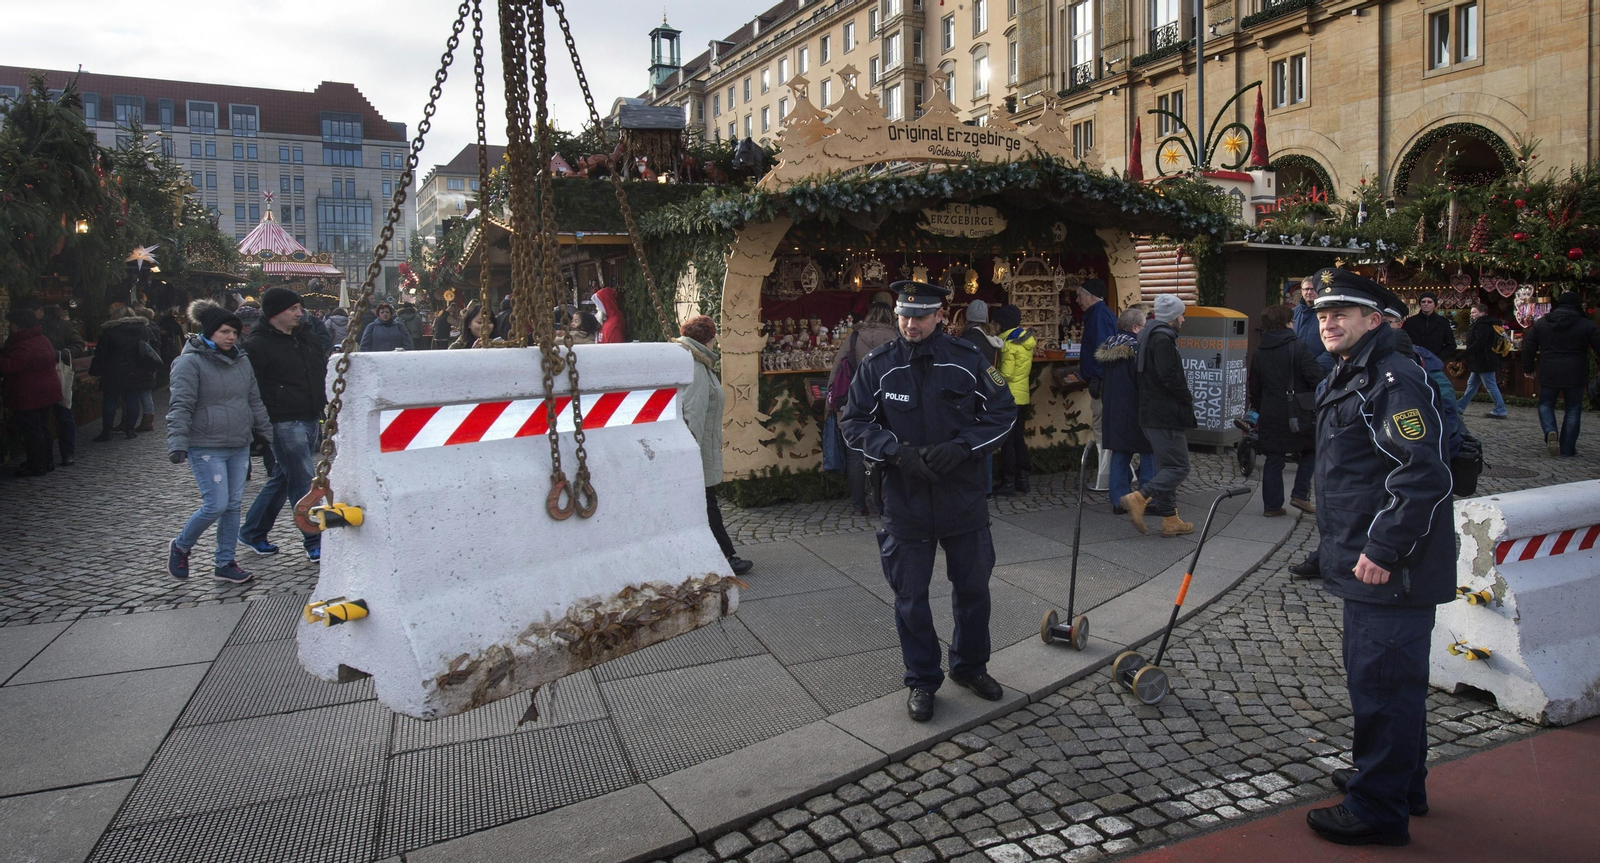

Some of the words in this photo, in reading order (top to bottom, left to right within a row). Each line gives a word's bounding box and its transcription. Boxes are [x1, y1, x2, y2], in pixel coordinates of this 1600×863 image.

[888, 124, 943, 142] Original
[947, 127, 1021, 151] Erzgebirge
[928, 144, 981, 159] Volkskunst
[946, 205, 981, 215] ECHT
[931, 214, 994, 226] ERZGEBIRGE
[1177, 338, 1224, 350] IERKORB
[1182, 358, 1207, 370] URA
[1396, 411, 1418, 421] POLIZEI
